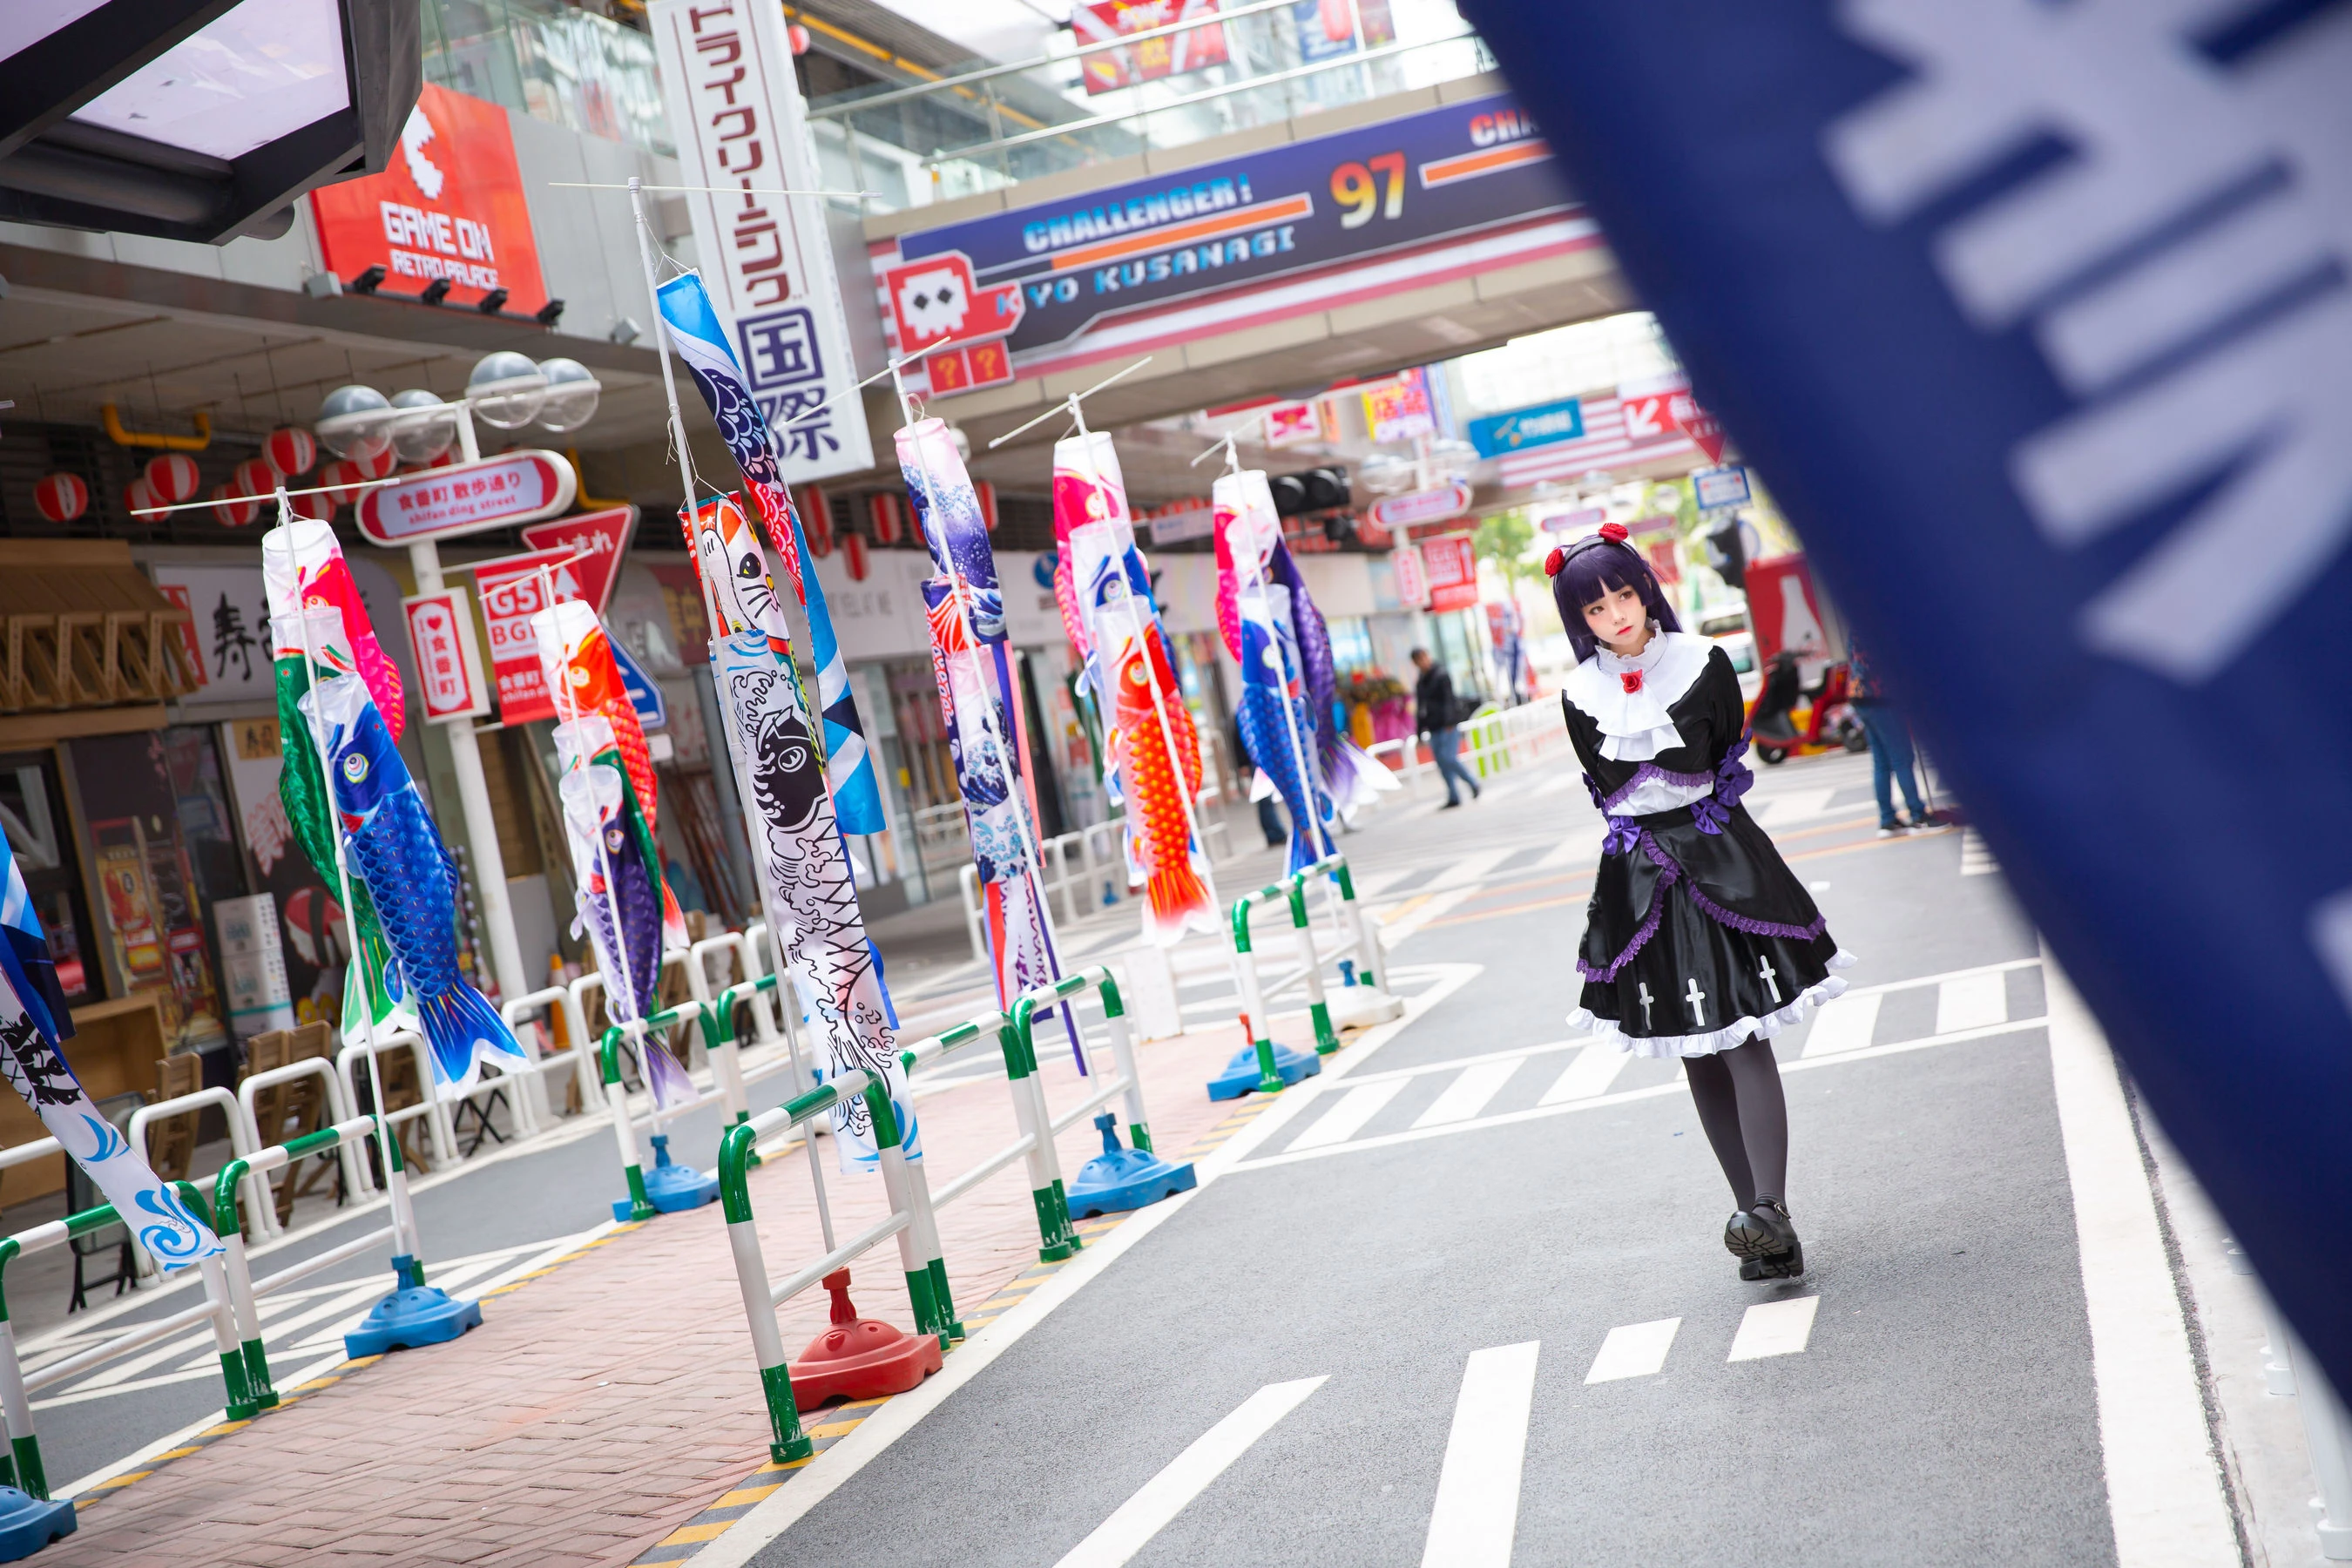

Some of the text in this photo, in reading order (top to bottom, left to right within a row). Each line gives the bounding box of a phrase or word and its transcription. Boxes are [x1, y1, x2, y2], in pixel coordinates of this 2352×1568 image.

[1023, 173, 1253, 253] CHALLENGER!
[1329, 150, 1407, 230] 97
[380, 200, 495, 264] GAME ON
[389, 248, 499, 291] RETRO PALACE
[997, 226, 1296, 317] KYO KUSANAGI
[397, 486, 448, 511] 食番町
[409, 510, 446, 524] shifan
[480, 494, 517, 510] street
[488, 574, 539, 616] G5
